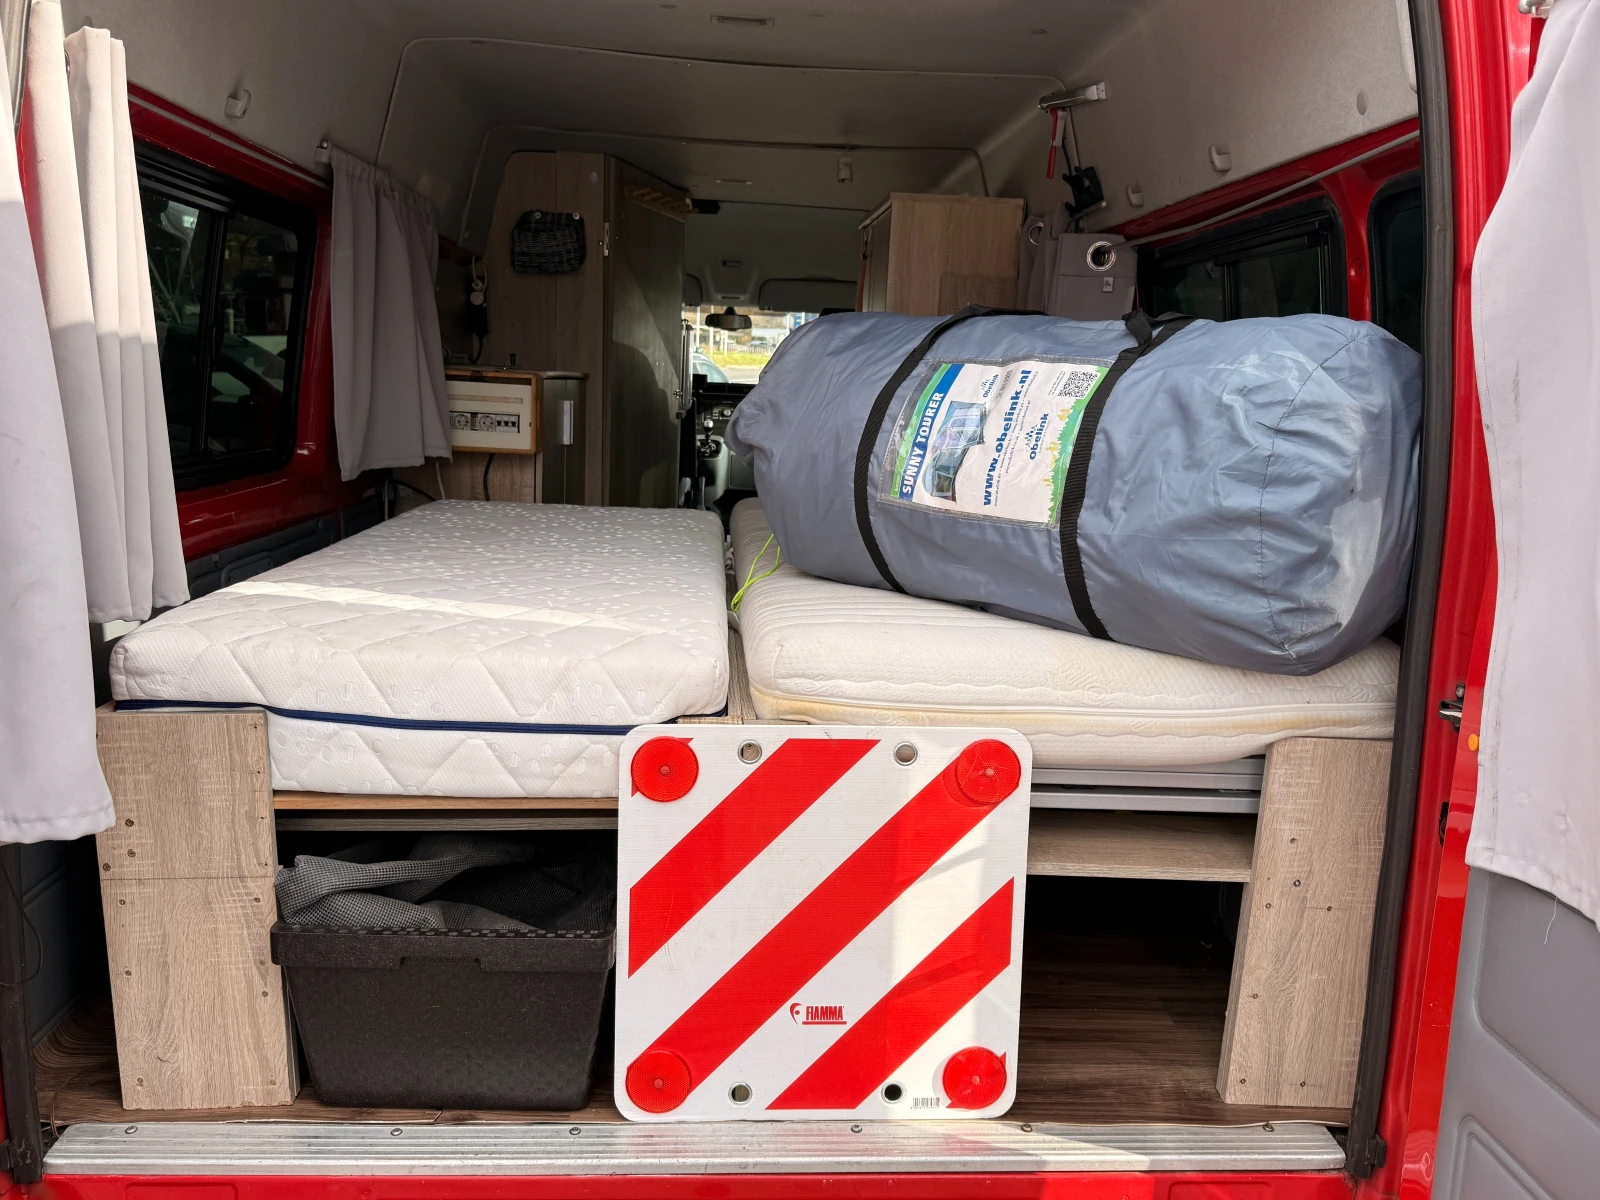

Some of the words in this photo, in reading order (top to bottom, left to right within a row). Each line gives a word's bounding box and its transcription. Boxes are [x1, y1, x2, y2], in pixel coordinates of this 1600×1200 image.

[902, 446, 924, 495] SUNNY
[915, 391, 944, 443] TOURER
[983, 369, 1032, 506] www.obelink.nl
[805, 1005, 843, 1021] FIAMMA
